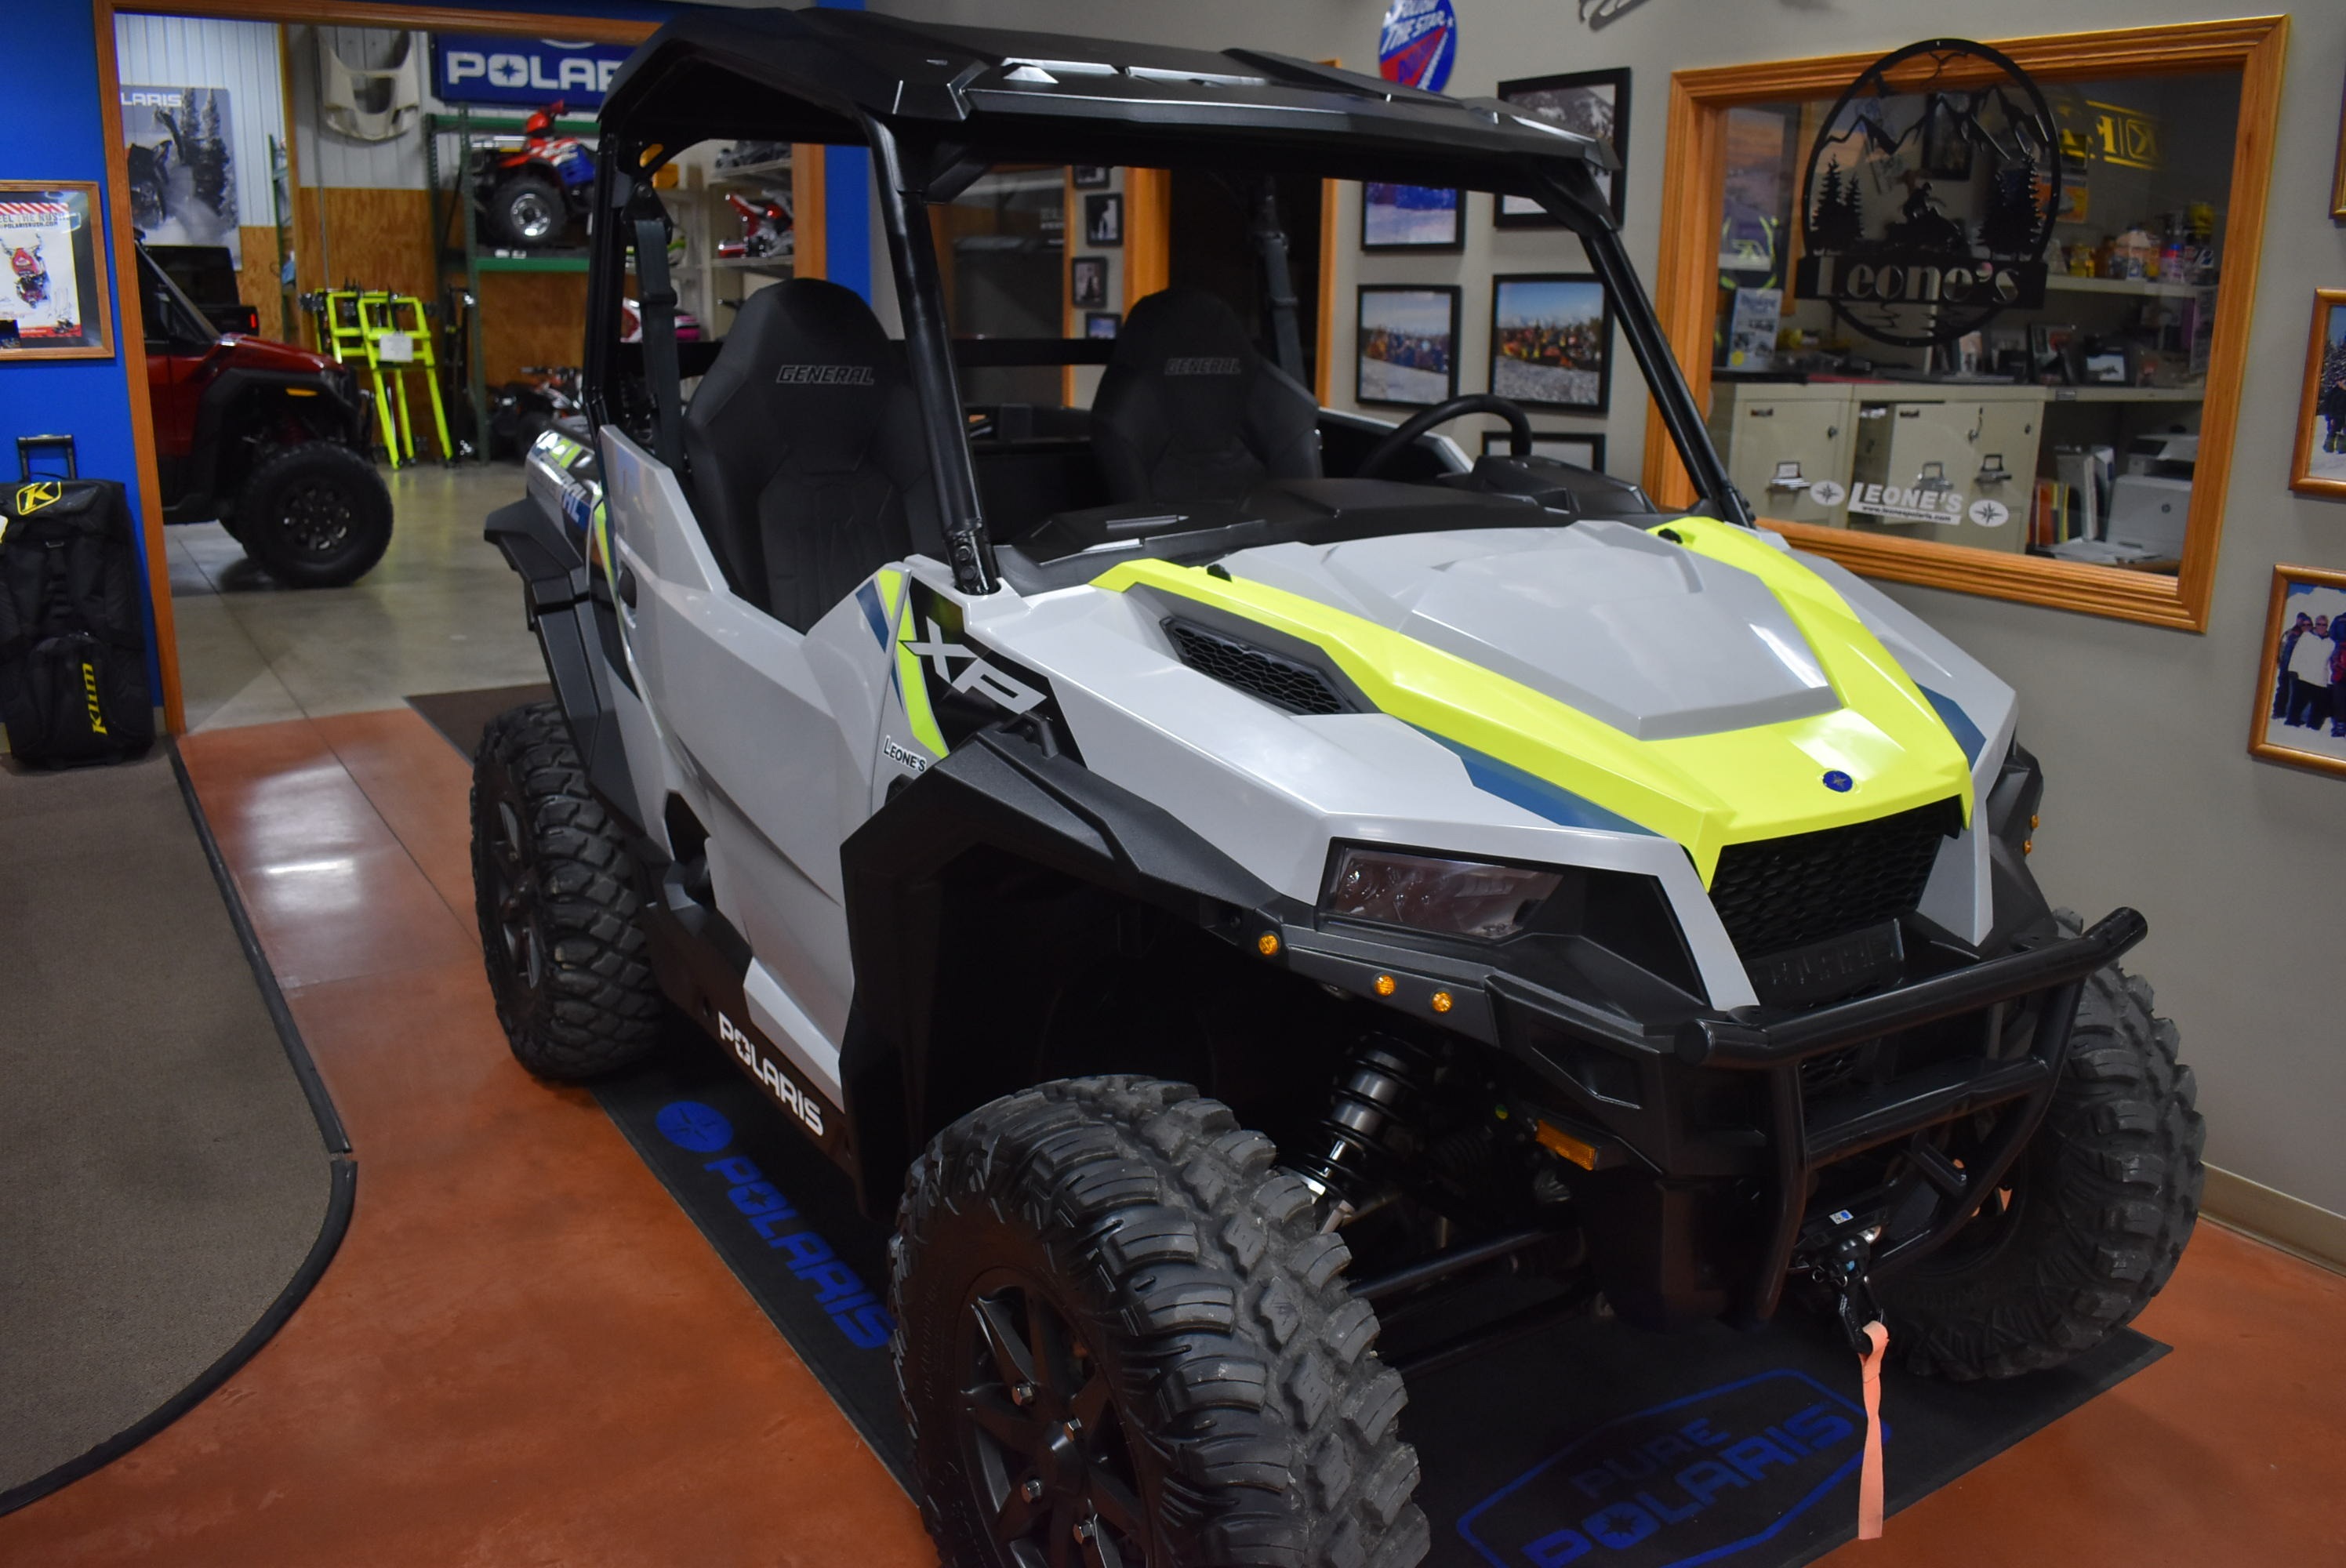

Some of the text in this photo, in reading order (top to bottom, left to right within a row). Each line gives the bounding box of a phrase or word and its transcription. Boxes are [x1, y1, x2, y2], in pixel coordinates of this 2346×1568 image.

[1815, 255, 2020, 304] Leone's
[776, 364, 875, 386] GENERAL
[1164, 357, 1241, 376] GENERAL
[1847, 481, 1964, 514] LEONE'S
[902, 615, 1048, 715] XP
[883, 737, 928, 773] LEONE'S
[718, 1011, 824, 1137] POLARIS
[704, 1156, 899, 1349] POLARIS
[1521, 1402, 1855, 1568] POLARIS
[1567, 1416, 1731, 1500] PURE
